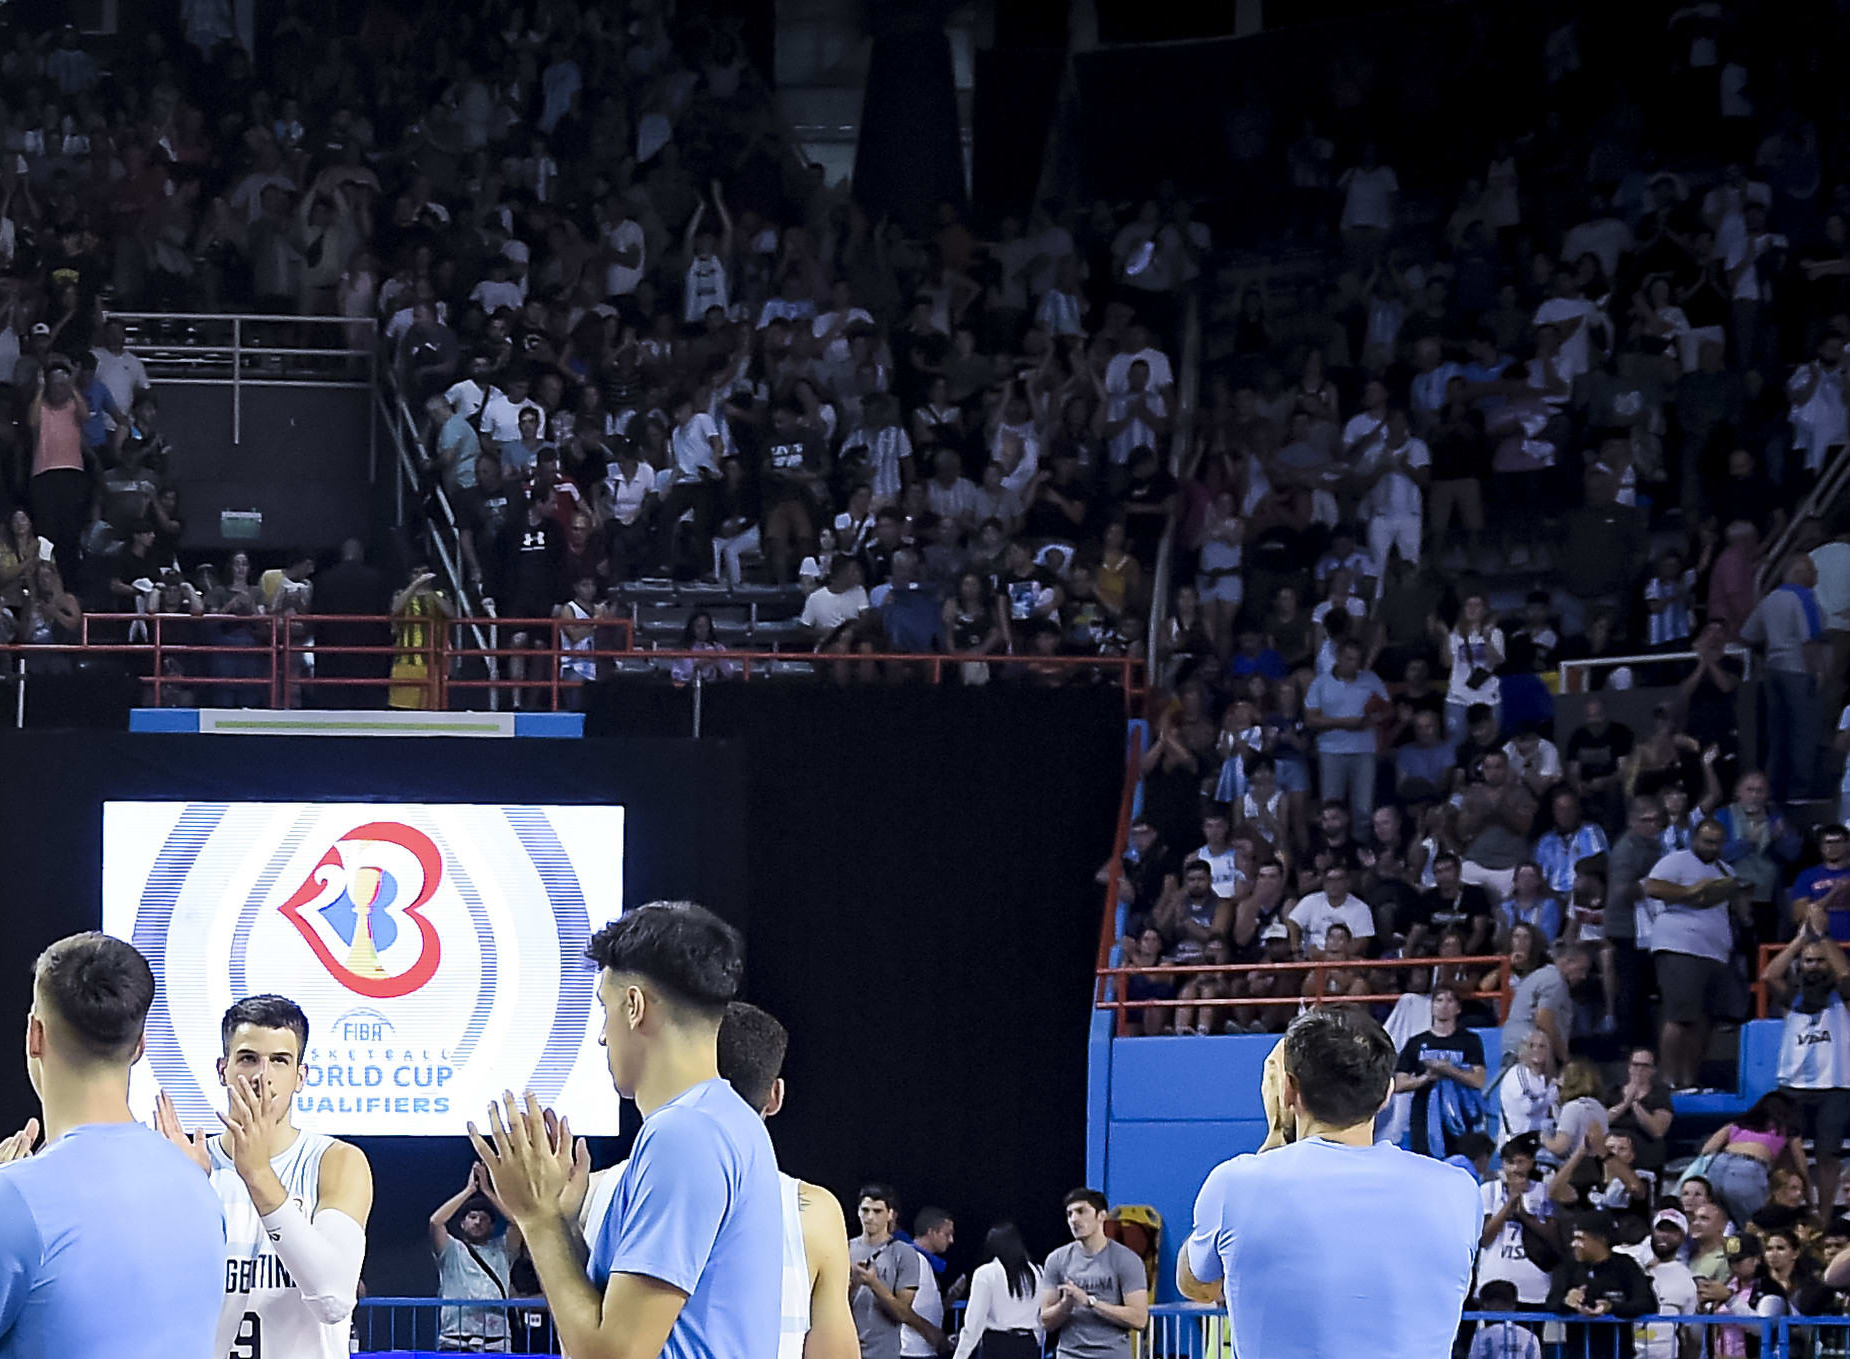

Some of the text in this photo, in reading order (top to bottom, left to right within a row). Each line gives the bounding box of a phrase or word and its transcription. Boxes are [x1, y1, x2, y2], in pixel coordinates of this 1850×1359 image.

[344, 1022, 382, 1041] FIBA
[306, 1064, 453, 1087] ORLD CUP
[297, 1097, 449, 1113] UALIFIERS
